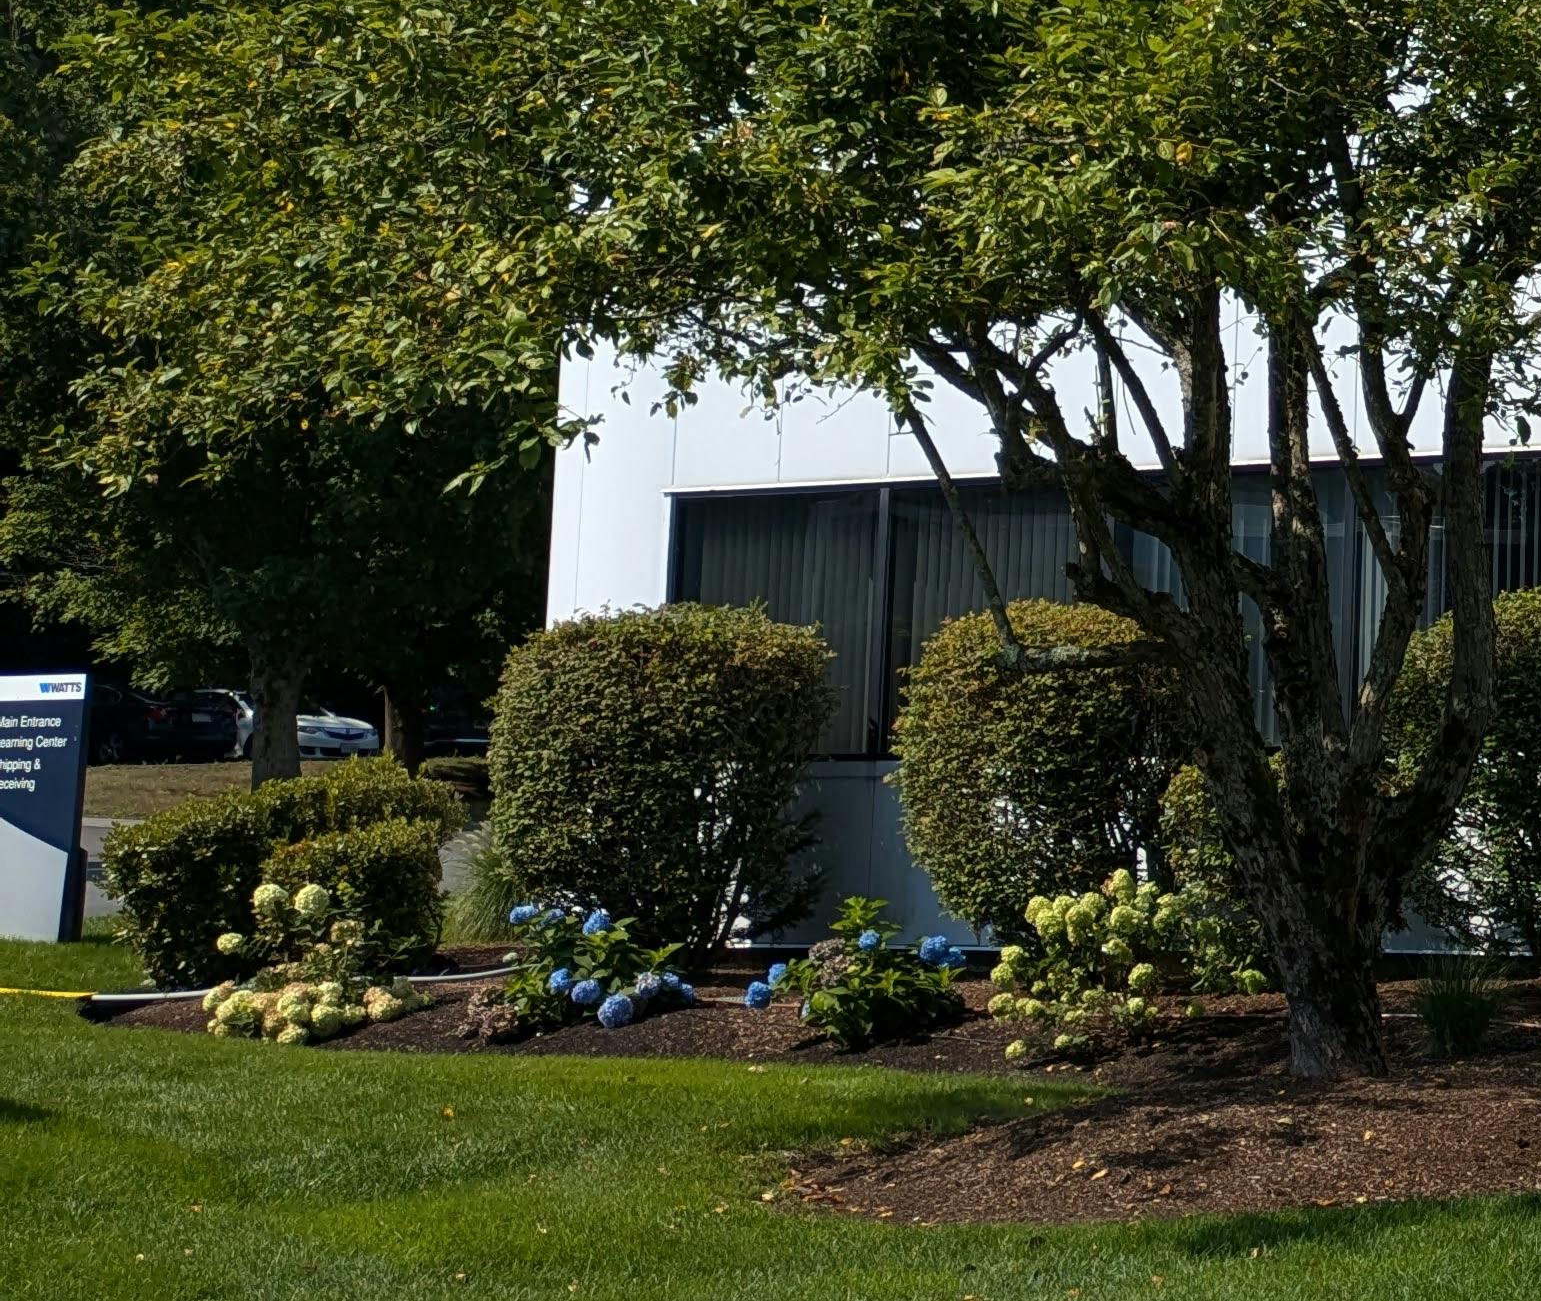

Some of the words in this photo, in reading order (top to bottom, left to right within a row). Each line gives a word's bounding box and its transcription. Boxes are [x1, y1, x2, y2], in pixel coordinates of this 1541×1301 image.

[51, 682, 82, 693] WATTS
[20, 715, 62, 728] Entrance
[0, 736, 33, 751] earning
[35, 735, 68, 748] Center
[0, 757, 32, 773] hipping
[33, 757, 41, 770] &
[0, 777, 36, 792] eceiving
